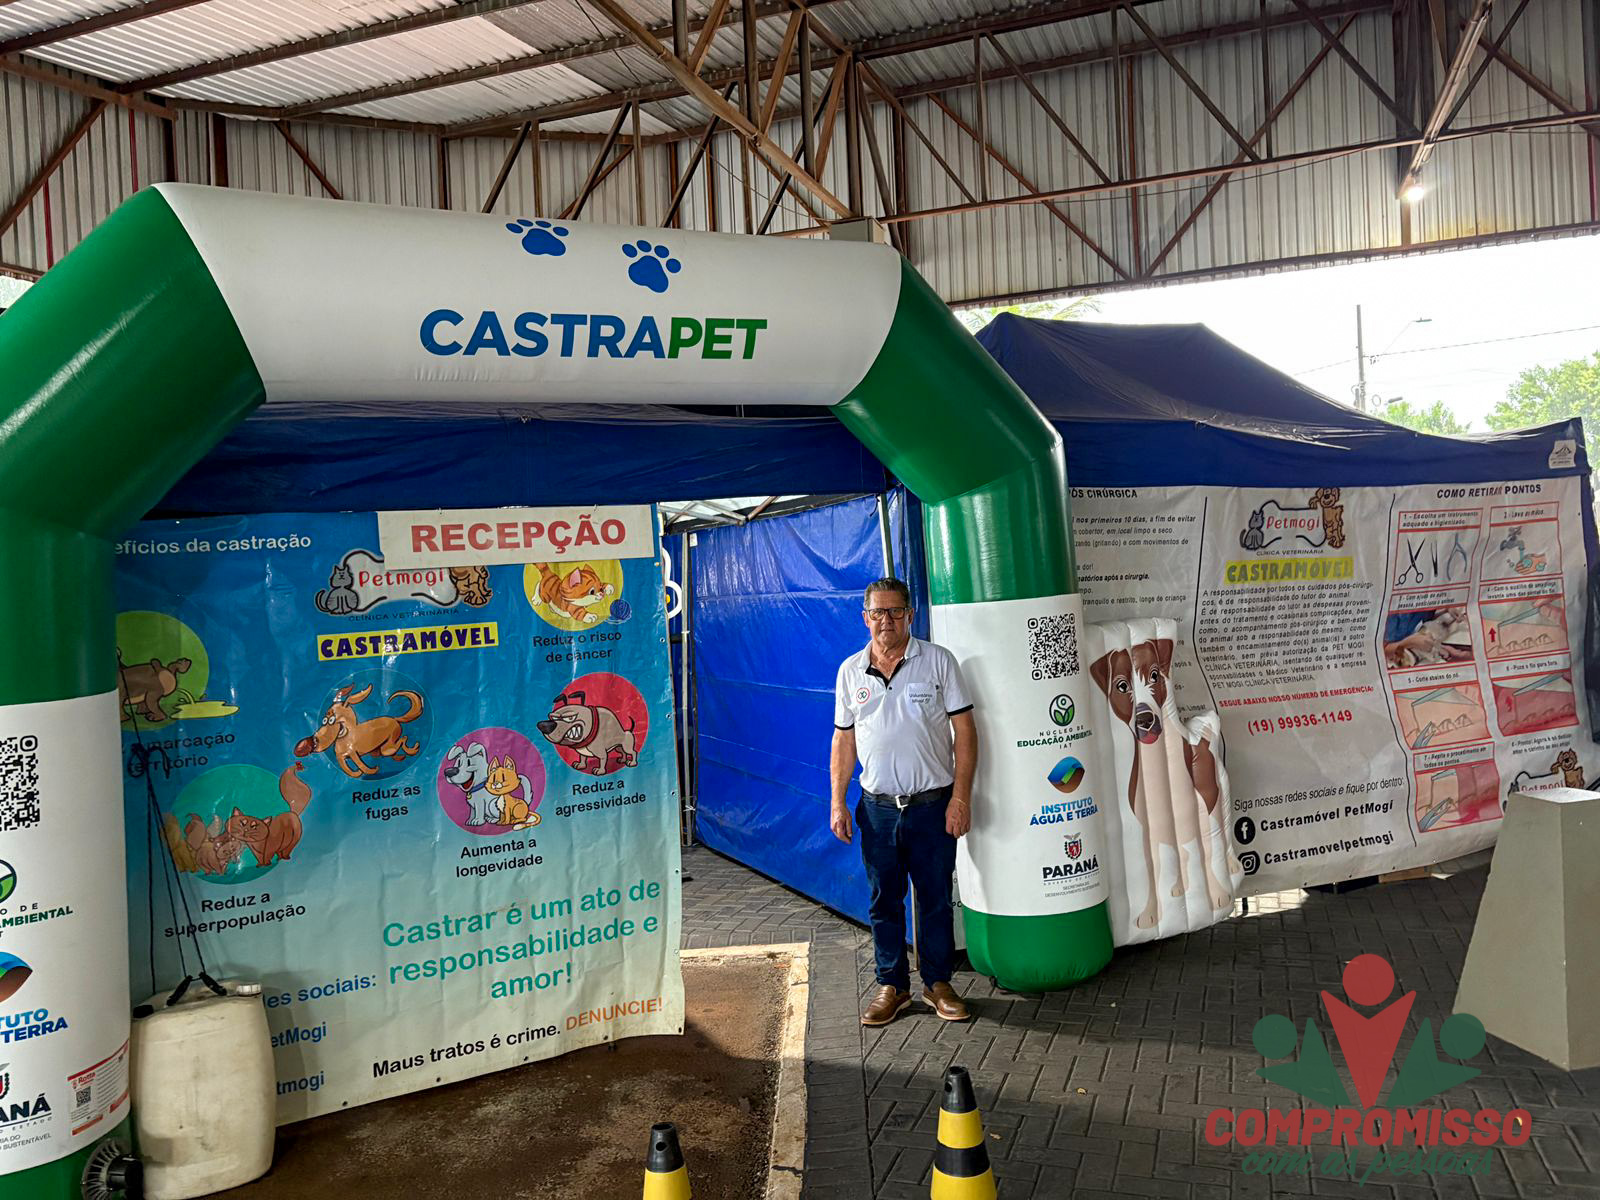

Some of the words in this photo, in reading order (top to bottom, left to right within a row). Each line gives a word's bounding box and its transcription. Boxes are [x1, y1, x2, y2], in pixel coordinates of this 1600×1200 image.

[419, 308, 768, 360] CASTRAPET
[1069, 488, 1084, 498] ÓS
[1087, 488, 1138, 498] CIRÚRGICA
[1437, 487, 1466, 499] COMO
[1504, 483, 1542, 494] PONTOS
[1266, 510, 1320, 533] Petmogi
[186, 539, 211, 552] da
[216, 533, 312, 552] castração
[410, 513, 626, 555] RECEPÇÃO
[358, 565, 446, 588] Petmogi
[1227, 560, 1351, 582] CASTRAMÓVEL
[1210, 587, 1266, 597] responsabilidade
[320, 625, 496, 659] CASTRAMÓVEL
[532, 634, 573, 648] Reduz
[578, 635, 586, 644] o
[590, 631, 622, 643] risco
[546, 650, 562, 663] de
[565, 648, 613, 662] câncer
[1219, 698, 1242, 707] SEGUE
[1040, 727, 1073, 736] NÚCLEO
[1248, 718, 1275, 736] (19)
[1278, 709, 1353, 730] 99936-1149
[1017, 734, 1064, 748] EDUCAÇÃO
[351, 786, 400, 804] Reduz
[404, 784, 421, 796] as
[572, 781, 608, 796] Reduz
[616, 780, 625, 790] a
[1234, 798, 1253, 812] Siga
[1254, 795, 1283, 808] nossas
[1285, 790, 1308, 804] redes
[1309, 786, 1336, 800] sociais
[1345, 783, 1365, 796] fique
[1366, 782, 1379, 794] por
[1380, 777, 1405, 790] dentro:
[365, 804, 408, 820] fugas
[555, 791, 646, 817] agressividade
[1030, 811, 1064, 826] ÁGUA
[1067, 811, 1073, 821] E
[1074, 805, 1098, 820] TERRA
[1041, 796, 1093, 815] INSTITUTO
[1260, 808, 1340, 832] Castramóvel
[1344, 800, 1394, 818] PetMogi
[460, 840, 526, 859] Aumenta
[528, 838, 538, 848] a
[1264, 830, 1394, 865] Castramovelpetmogi
[456, 854, 544, 878] longevidade
[1042, 854, 1098, 879] PARANÁ
[20, 902, 38, 912] DE
[201, 892, 255, 913] Reduz
[260, 892, 270, 903] a
[383, 910, 498, 947] Castrar
[506, 902, 522, 925] é
[530, 896, 572, 920] um
[580, 886, 622, 912] ato
[628, 879, 661, 901] de
[164, 904, 306, 938] superpopulação
[390, 916, 635, 984] responsabilidade
[643, 915, 658, 932] e
[263, 992, 292, 1009] es
[298, 974, 377, 1002] sociais:
[490, 962, 572, 1000] amor!
[1, 1017, 68, 1044] TERRA
[372, 1054, 425, 1078] Maus
[429, 1038, 486, 1063] tratos
[490, 1034, 501, 1049] é
[506, 1022, 562, 1047] crime.
[566, 997, 663, 1030] DENUNCIE!
